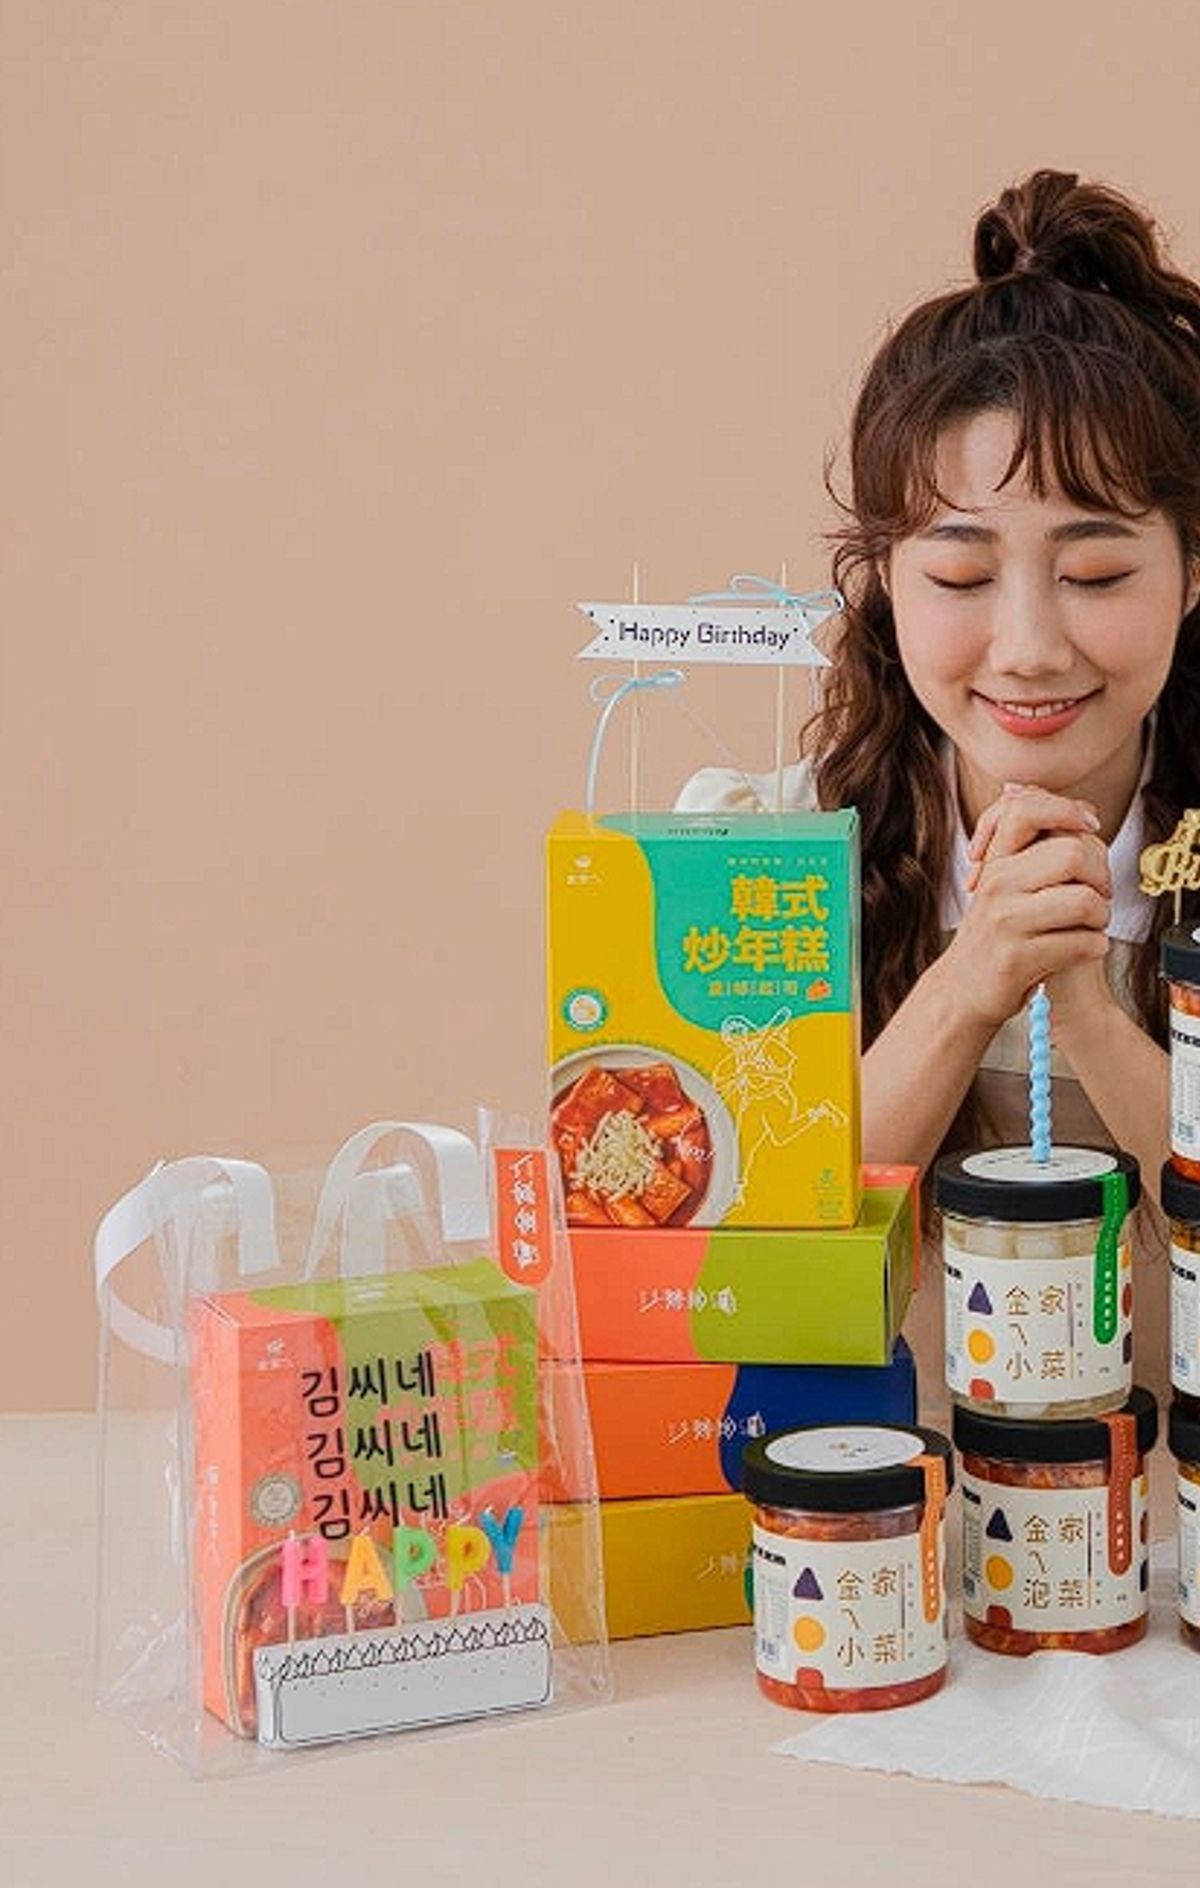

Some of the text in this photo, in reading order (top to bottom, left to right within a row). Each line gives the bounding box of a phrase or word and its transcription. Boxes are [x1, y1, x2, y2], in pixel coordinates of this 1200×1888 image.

[619, 621, 790, 650] Happy Birthday
[731, 873, 829, 922] 韓式
[683, 925, 829, 973] 炒年糕
[1006, 1285, 1065, 1316] 金家
[302, 1351, 436, 1418] 김씨네
[306, 1412, 442, 1479] 김씨네
[312, 1474, 449, 1540] 김씨네
[1024, 1513, 1084, 1544] 金家
[281, 1506, 524, 1607] HAPPY
[837, 1567, 898, 1601] 金家
